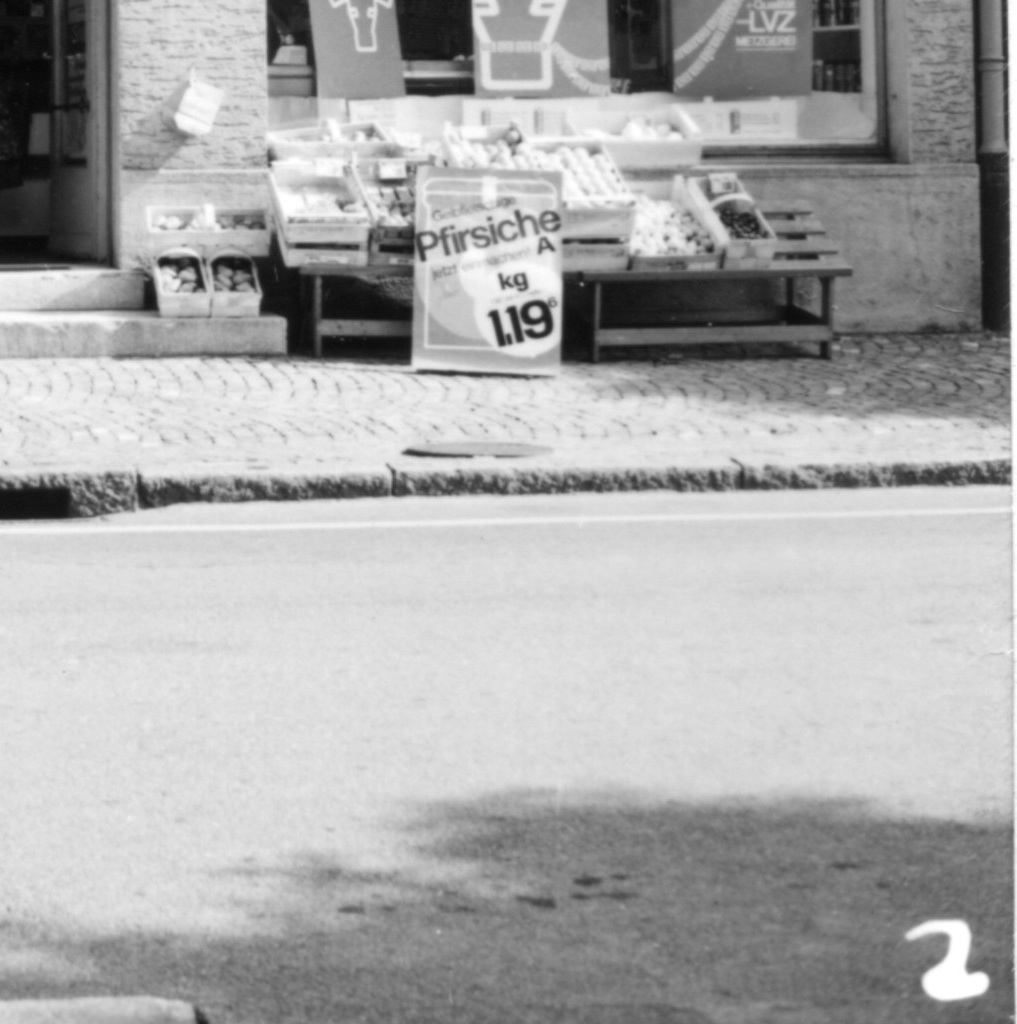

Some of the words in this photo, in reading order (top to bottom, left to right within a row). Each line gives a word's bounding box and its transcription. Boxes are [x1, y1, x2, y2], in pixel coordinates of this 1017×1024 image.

[415, 210, 561, 262] Pfirsiche
[537, 236, 555, 255] A
[498, 272, 528, 291] kg
